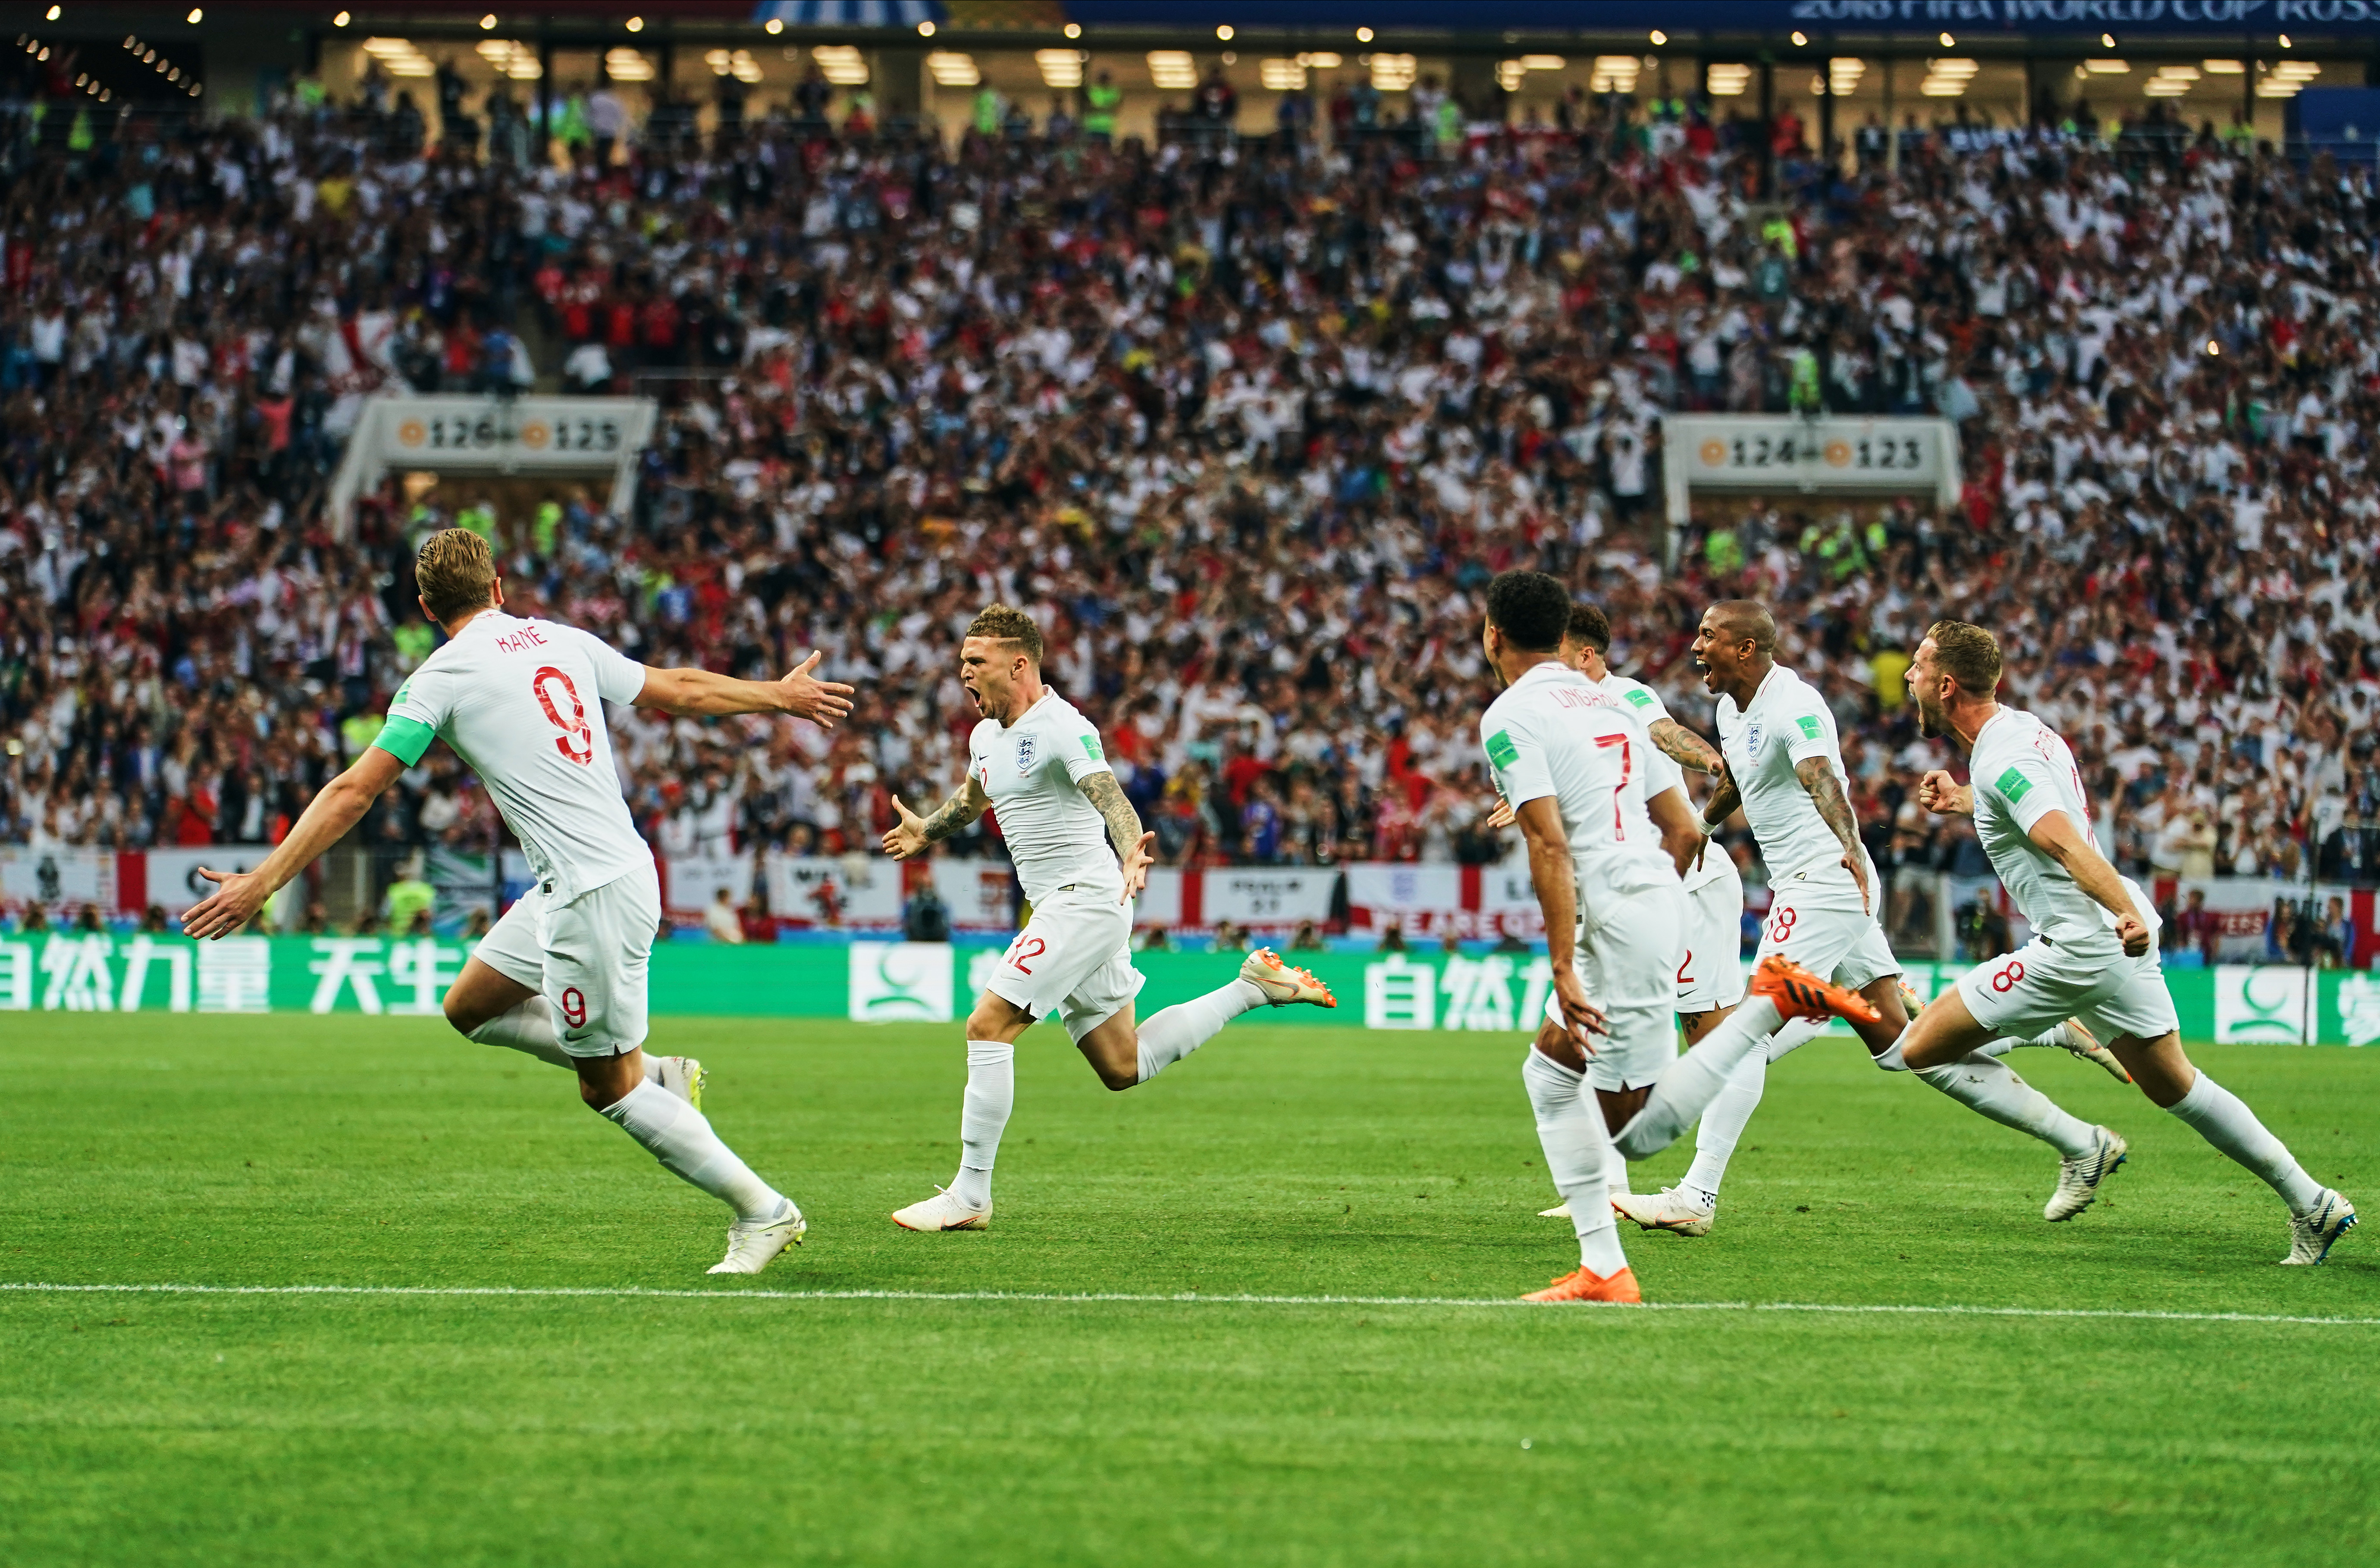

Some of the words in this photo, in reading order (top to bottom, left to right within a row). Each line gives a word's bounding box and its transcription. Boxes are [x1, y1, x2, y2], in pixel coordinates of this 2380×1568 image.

[1732, 434, 1795, 468] 124
[1857, 435, 1921, 470] 123
[494, 626, 548, 653] KANE
[533, 666, 592, 767] 9
[1593, 733, 1631, 842] 7
[1765, 907, 1796, 943] 18
[1008, 934, 1045, 976] 12
[1993, 961, 2024, 992] 8
[562, 987, 586, 1029] 9
